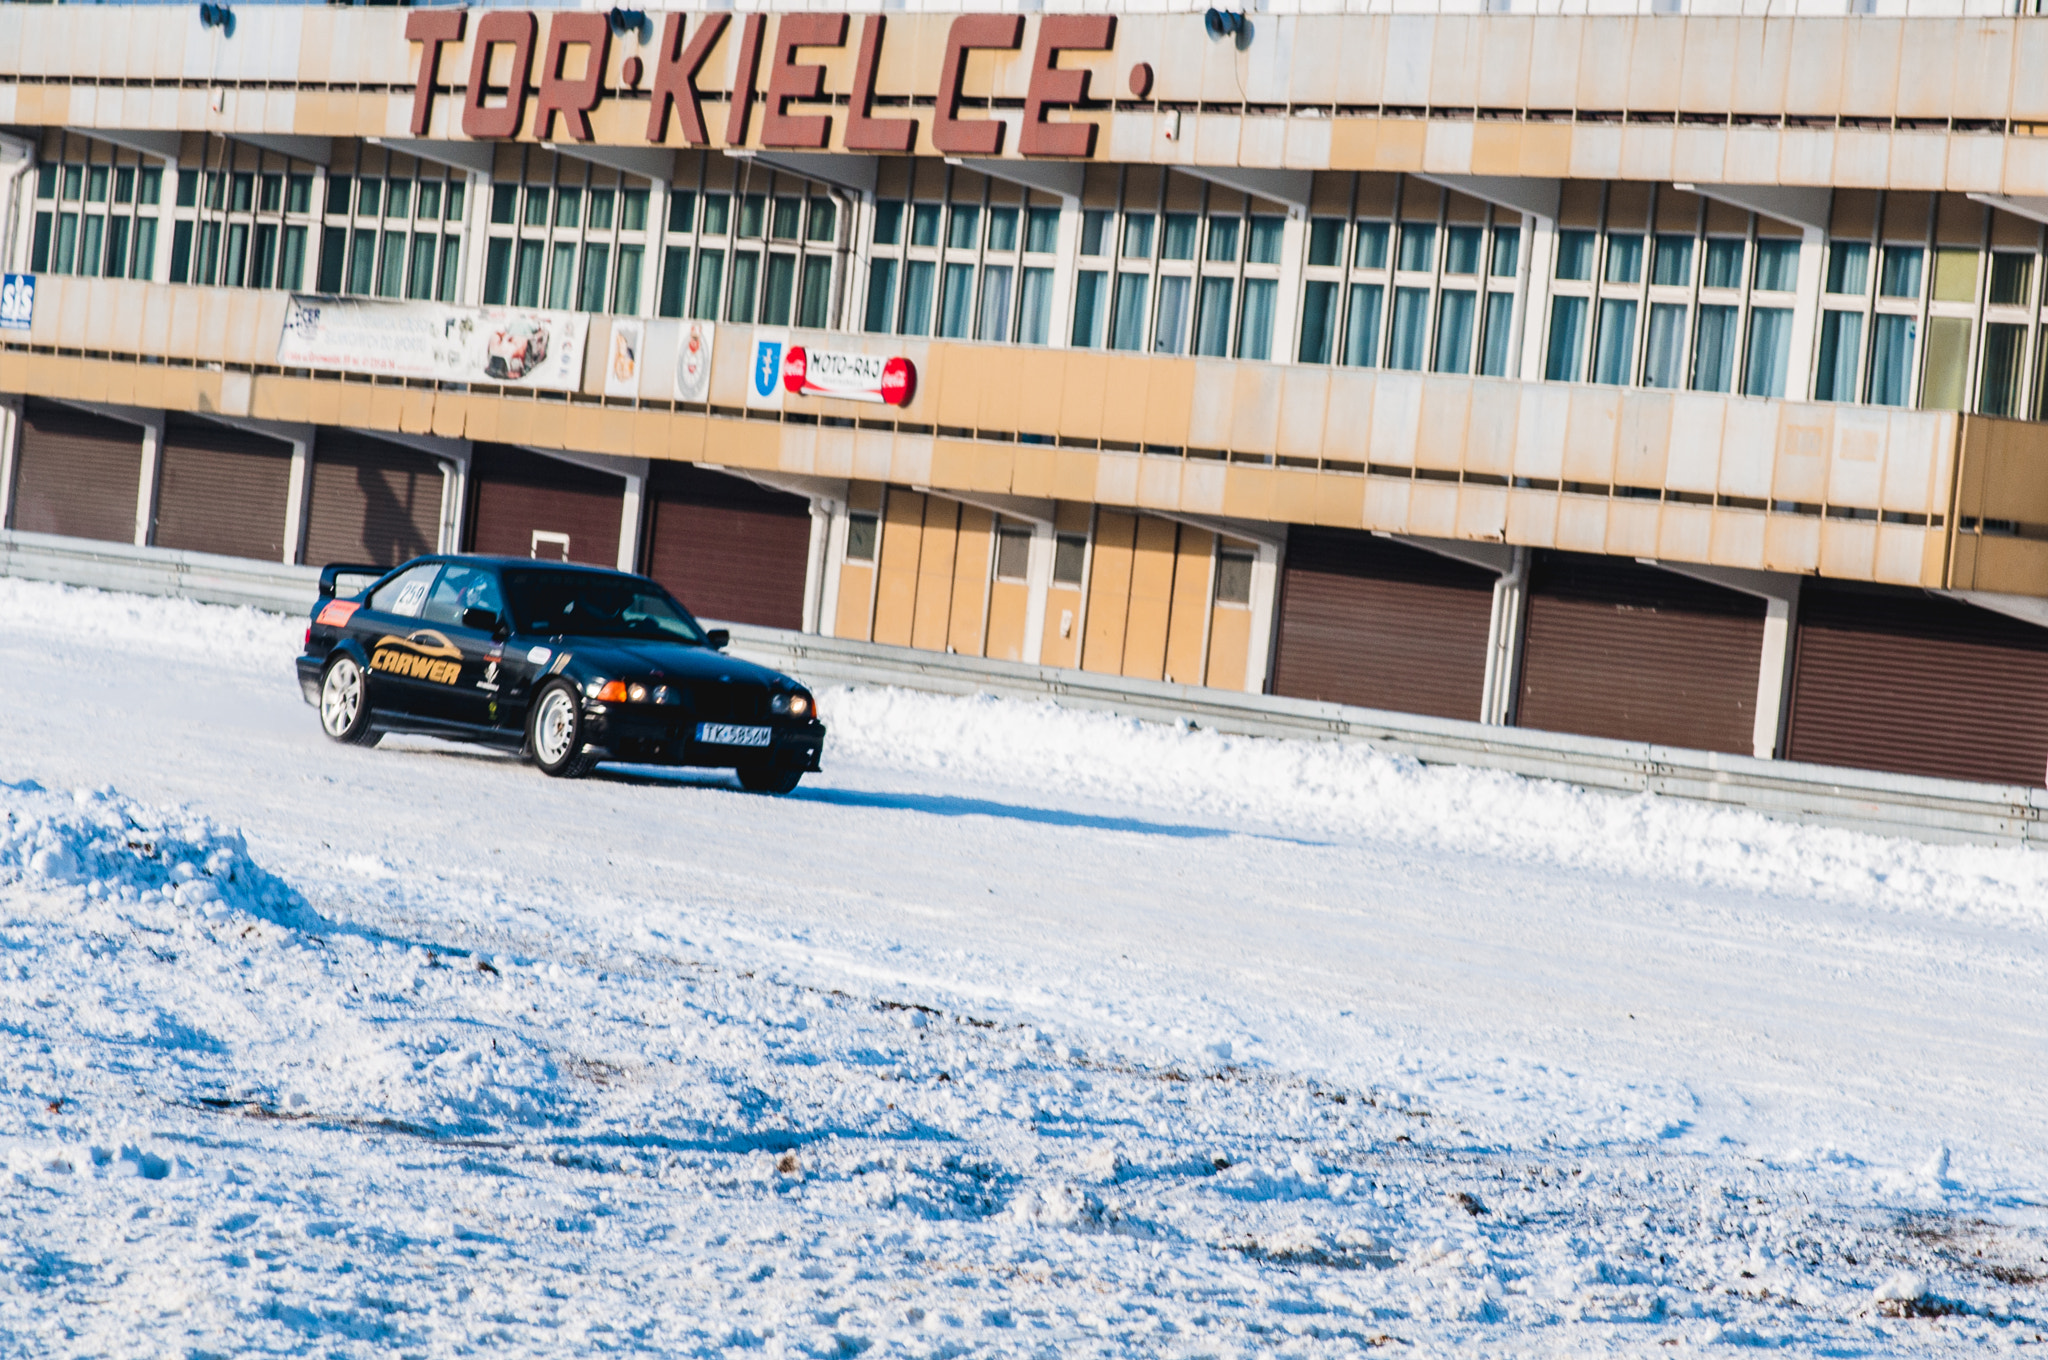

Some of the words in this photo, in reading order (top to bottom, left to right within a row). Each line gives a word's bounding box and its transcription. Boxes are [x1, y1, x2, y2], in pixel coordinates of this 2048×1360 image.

[404, 10, 607, 141] TOR
[645, 12, 1118, 158] KIELCE
[811, 353, 881, 379] MOTO-RAJ
[370, 649, 463, 686] CARWER
